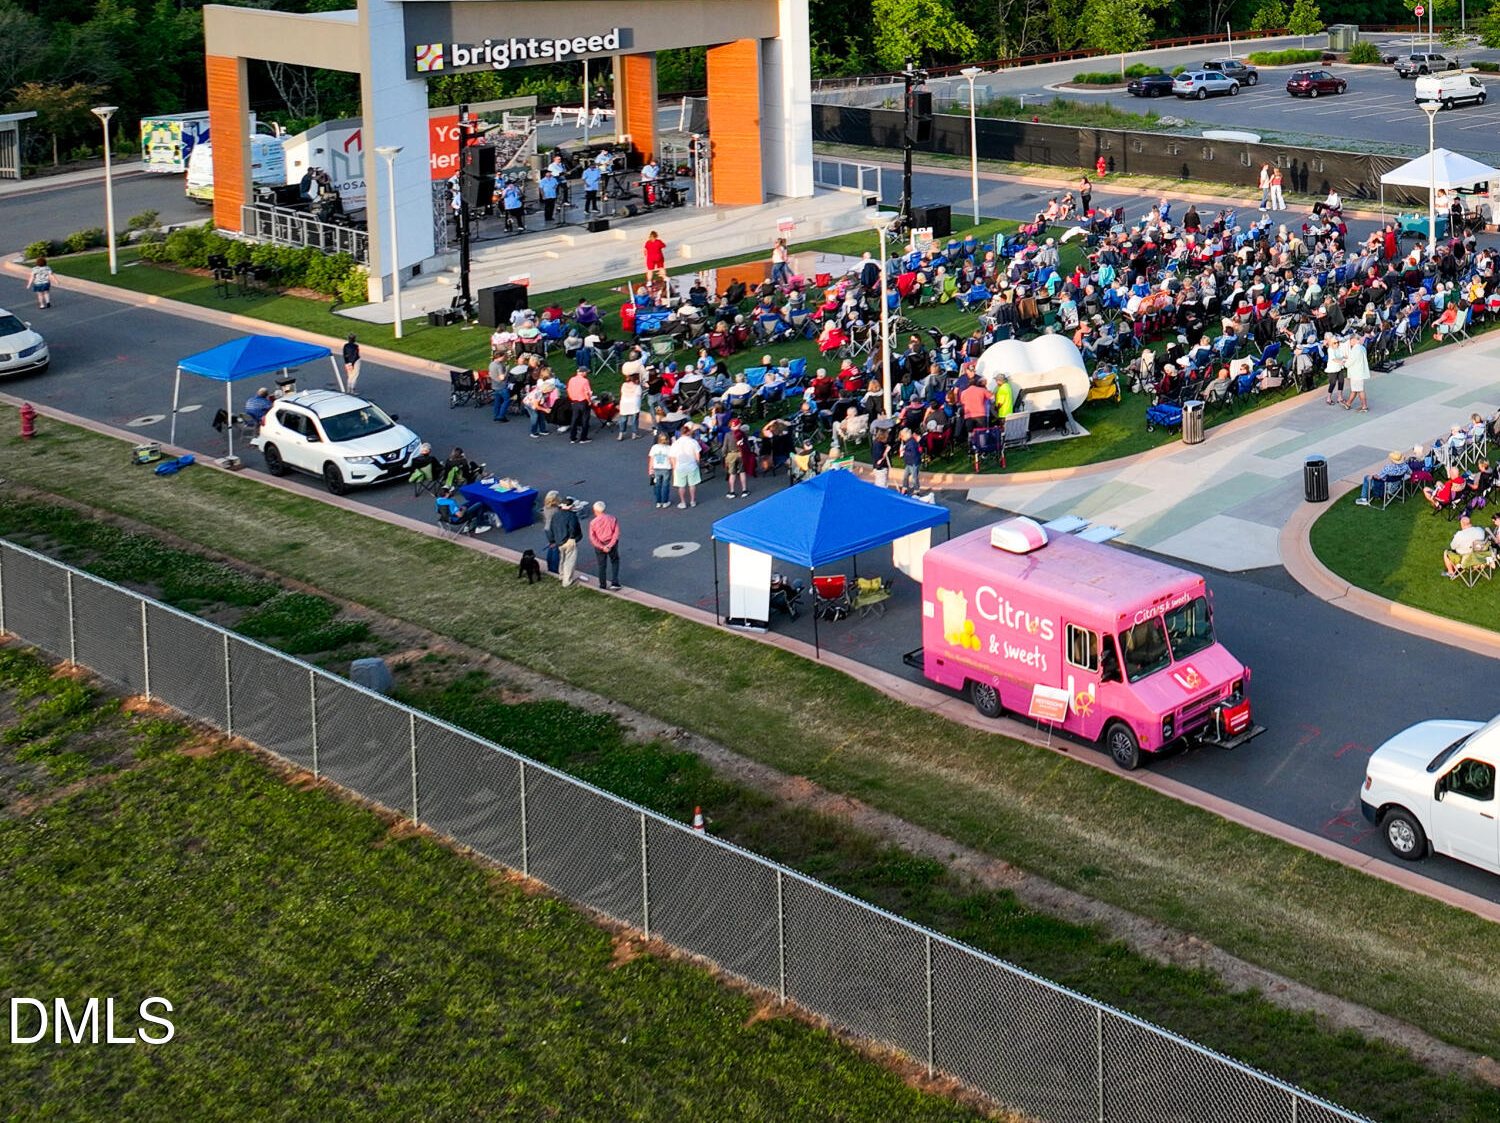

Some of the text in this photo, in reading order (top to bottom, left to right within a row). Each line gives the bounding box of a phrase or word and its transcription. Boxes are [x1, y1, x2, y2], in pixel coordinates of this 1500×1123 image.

[451, 27, 620, 69] brightspeed
[428, 152, 460, 169] Her
[333, 180, 367, 192] MOSA
[976, 585, 1054, 641] Citrus
[1134, 603, 1165, 625] Citrus
[989, 634, 1000, 655] &
